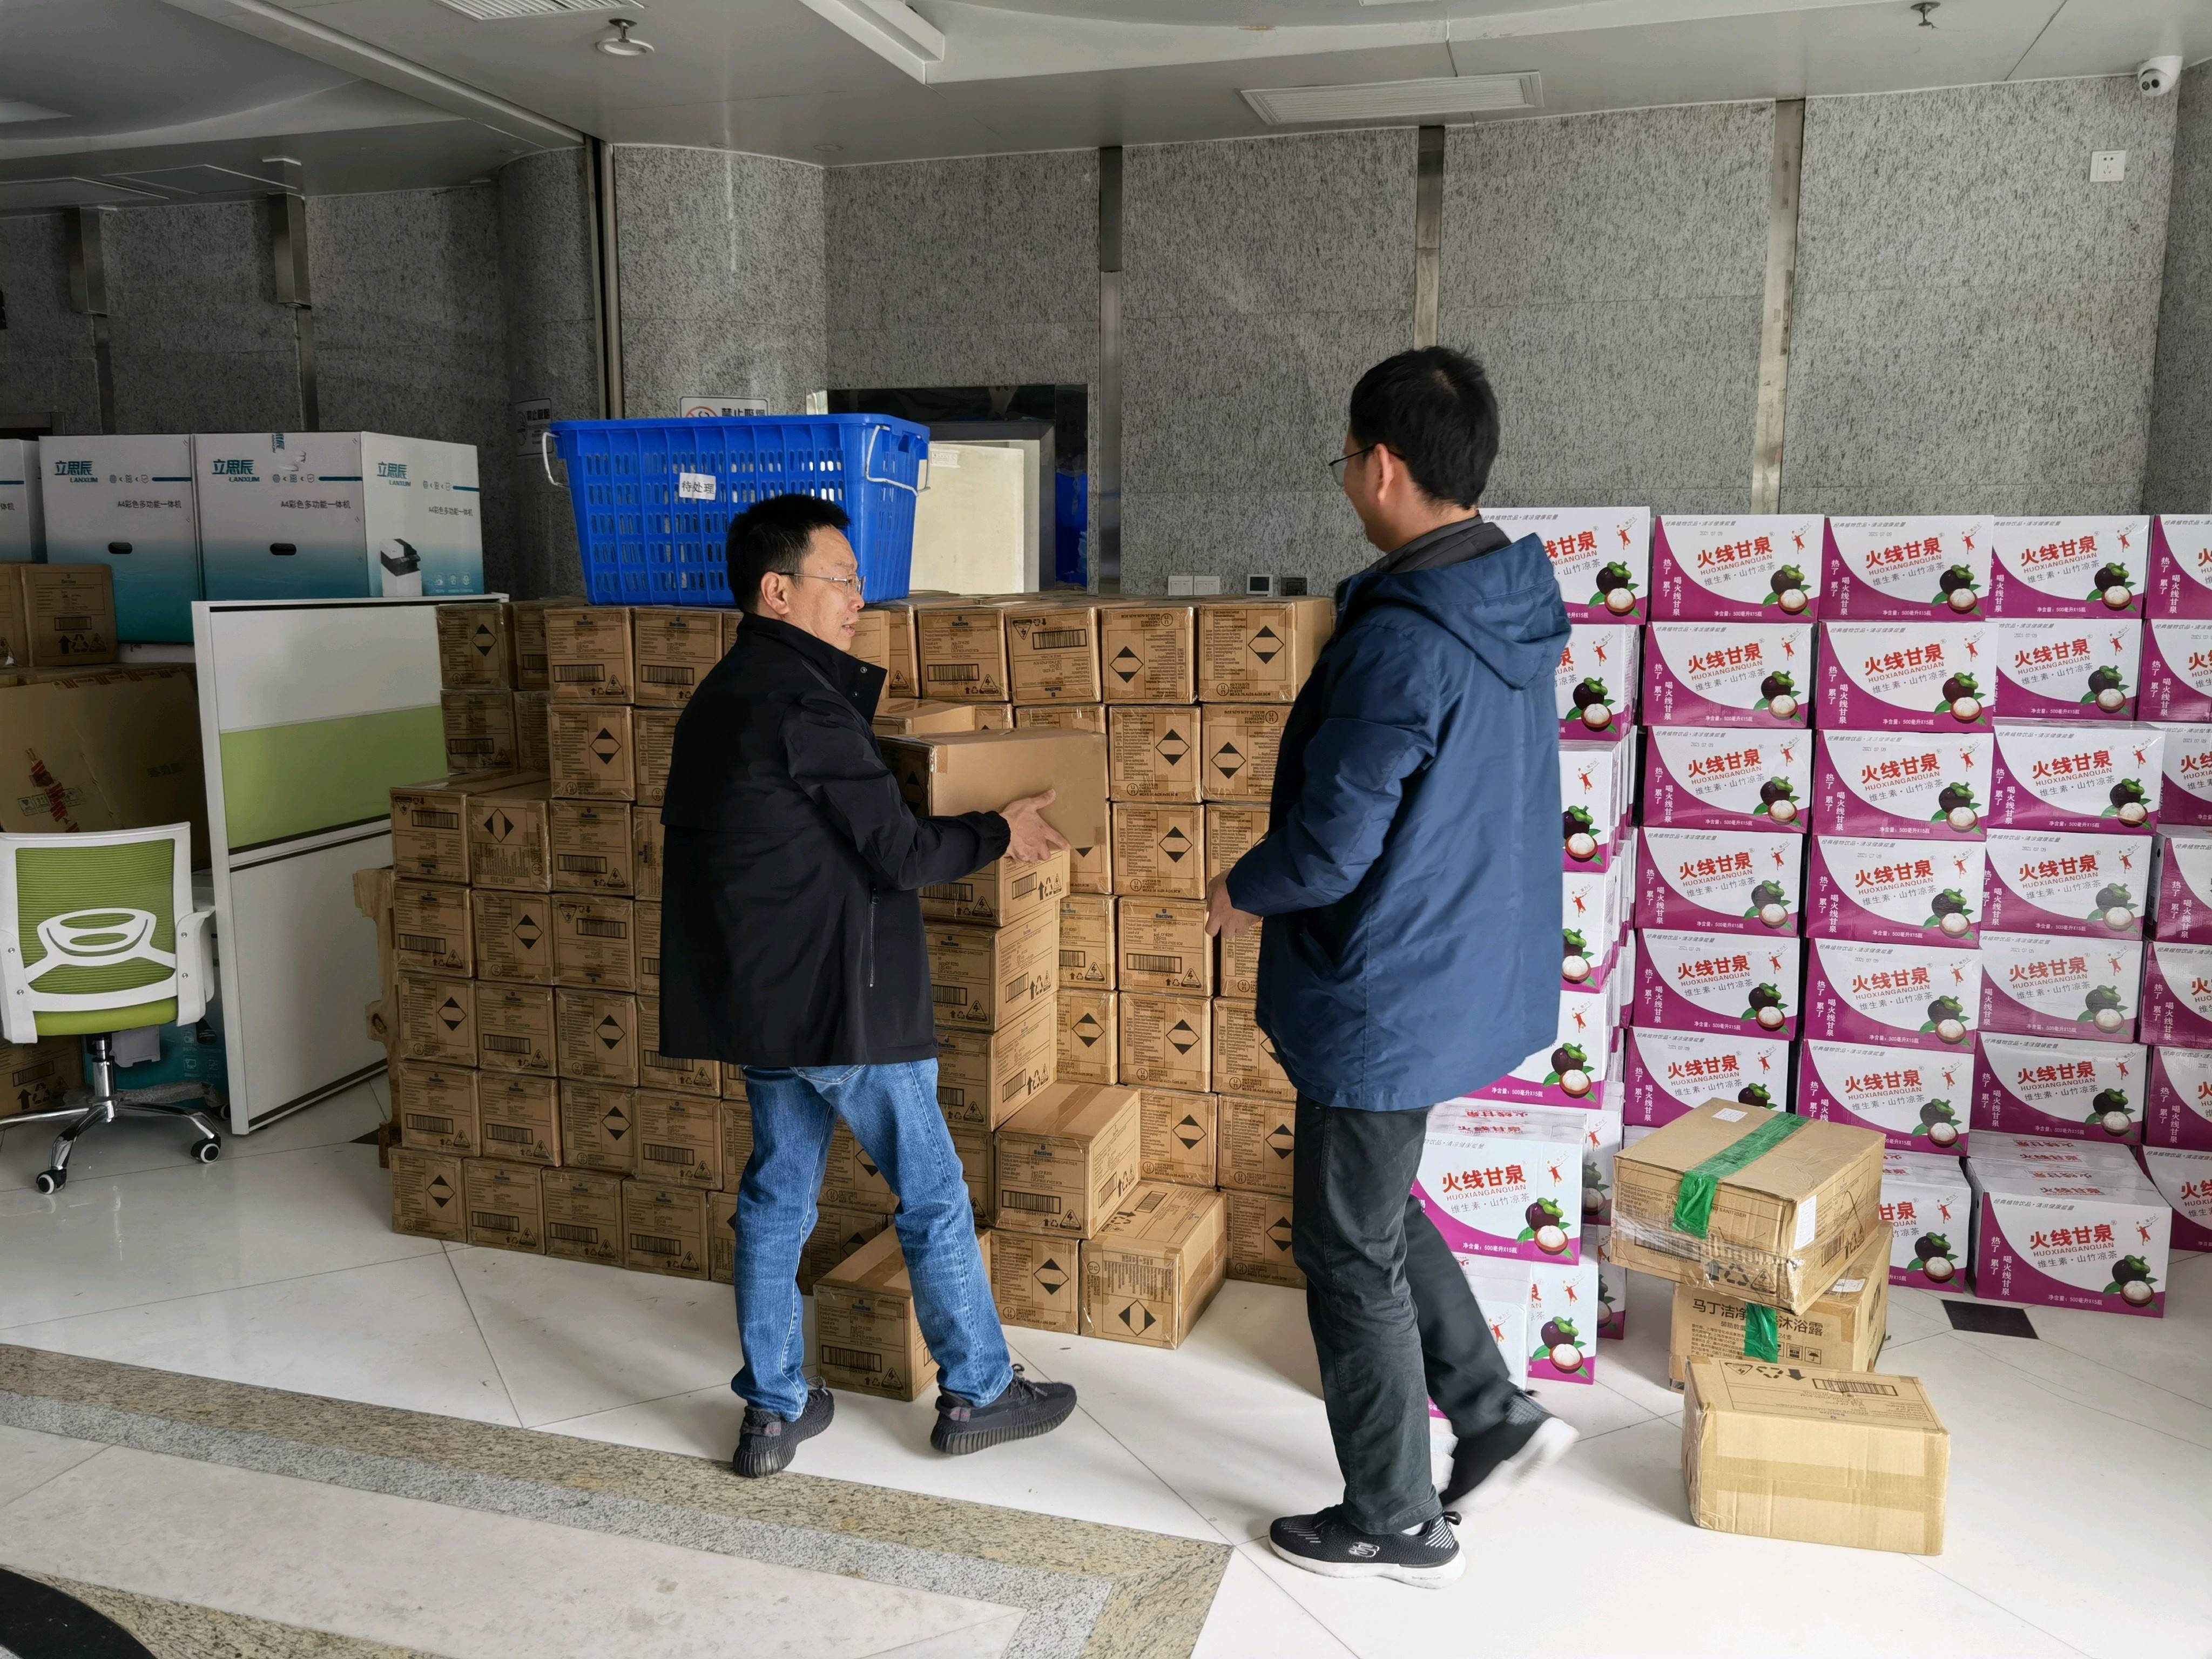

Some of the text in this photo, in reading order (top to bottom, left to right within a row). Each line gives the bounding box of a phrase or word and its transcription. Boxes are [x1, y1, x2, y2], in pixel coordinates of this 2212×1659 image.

[55, 460, 93, 476] 立思辰
[212, 459, 254, 475] 立思辰
[377, 461, 407, 479] 立思辰
[682, 481, 714, 494] 待处理
[281, 500, 351, 509] A4彩色多功能一体机
[1545, 531, 1598, 559] 线甘泉
[1697, 536, 1773, 569] 火线甘泉
[1866, 537, 1942, 569] 火线甘泉
[2021, 536, 2098, 567] 火线甘泉
[1552, 550, 1597, 567] NGANQUAN
[1701, 554, 1772, 575] HUOXIANGANQUAN
[1869, 555, 1941, 575] HUOXIANGANQUAN
[2024, 552, 2096, 573] HUOXIANGANQUAN
[1673, 577, 1681, 616] 喝火线甘泉
[1840, 577, 1850, 615] 喝火线甘泉
[1689, 643, 1763, 674] 火线甘泉
[1865, 643, 1945, 676] 火线甘泉
[2015, 638, 2090, 668] 火线甘泉
[2018, 656, 2089, 674] HUOXIANGANQUAN
[1654, 664, 1662, 701] 热了 累了
[1691, 660, 1762, 680] HUOXIANGANQUAN
[1868, 662, 1944, 683] HUOXIANGANQUAN
[1829, 666, 1837, 704] 热了 累了
[2160, 678, 2171, 716] 喝火线甘泉
[1664, 682, 1673, 720] 喝火线甘泉
[1839, 684, 1848, 724] 喝火线甘泉
[1689, 748, 1762, 778] 火线甘泉
[1691, 766, 1761, 784] HUOXIANGANQUAN
[1862, 753, 1940, 784] 火线甘泉
[2033, 750, 2113, 779] 火线甘泉
[1865, 771, 1939, 791] HUOXIANGANQUAN
[2035, 768, 2112, 786] HUOXIANGANQUAN
[1680, 852, 1753, 880] 火线甘泉
[1683, 869, 1752, 886] HUOXIANGANQUAN
[1856, 860, 1934, 888] 火线甘泉
[2019, 854, 2099, 881] 火线甘泉
[1646, 869, 1654, 905] 热了 累了
[1858, 878, 1933, 894] HUOXIANGANQUAN
[2022, 872, 2098, 888] HUOXIANGANQUAN
[1656, 887, 1664, 924] 喝火线甘泉
[1678, 954, 1750, 980] 火线甘泉
[1681, 972, 1749, 987] HUOXIANGANQUAN
[1852, 967, 1931, 993] 火线甘泉
[2009, 956, 2088, 982] 火线甘泉
[1856, 984, 1930, 999] HUOXIANGANQUAN
[2013, 974, 2087, 989] HUOXIANGANQUAN
[1654, 986, 1662, 1023] 喝火线甘泉
[1816, 981, 1825, 1017] 热了 累了
[1826, 999, 1836, 1037] 喝火线甘泉
[1668, 1055, 1740, 1079] 火线甘泉
[1671, 1072, 1739, 1085] HUOXIANGANQUAN
[2018, 1061, 2096, 1085] 火线甘泉
[1845, 1069, 1922, 1094] 火线甘泉
[1848, 1087, 1921, 1100] HUOXIANGANQUAN
[2021, 1078, 2095, 1091] HUOXIANGANQUAN
[1644, 1085, 1653, 1121] 喝火线甘泉
[1991, 1091, 2001, 1127] 喝火线甘泉
[1442, 1164, 1527, 1193] 火线甘泉
[1446, 1184, 1526, 1201] HUOXIANGANQUAN
[1719, 1208, 1746, 1218] SANITISER
[1879, 1202, 1917, 1222] 甘泉
[2030, 1224, 2115, 1250] 火线甘泉
[2033, 1243, 2114, 1257] HUOXIANGANQUAN
[1991, 1237, 2000, 1274] 热了 累了
[2001, 1256, 2012, 1296] 喝火线甘泉
[1692, 1298, 1823, 1337] 马丁洁净沐浴露
